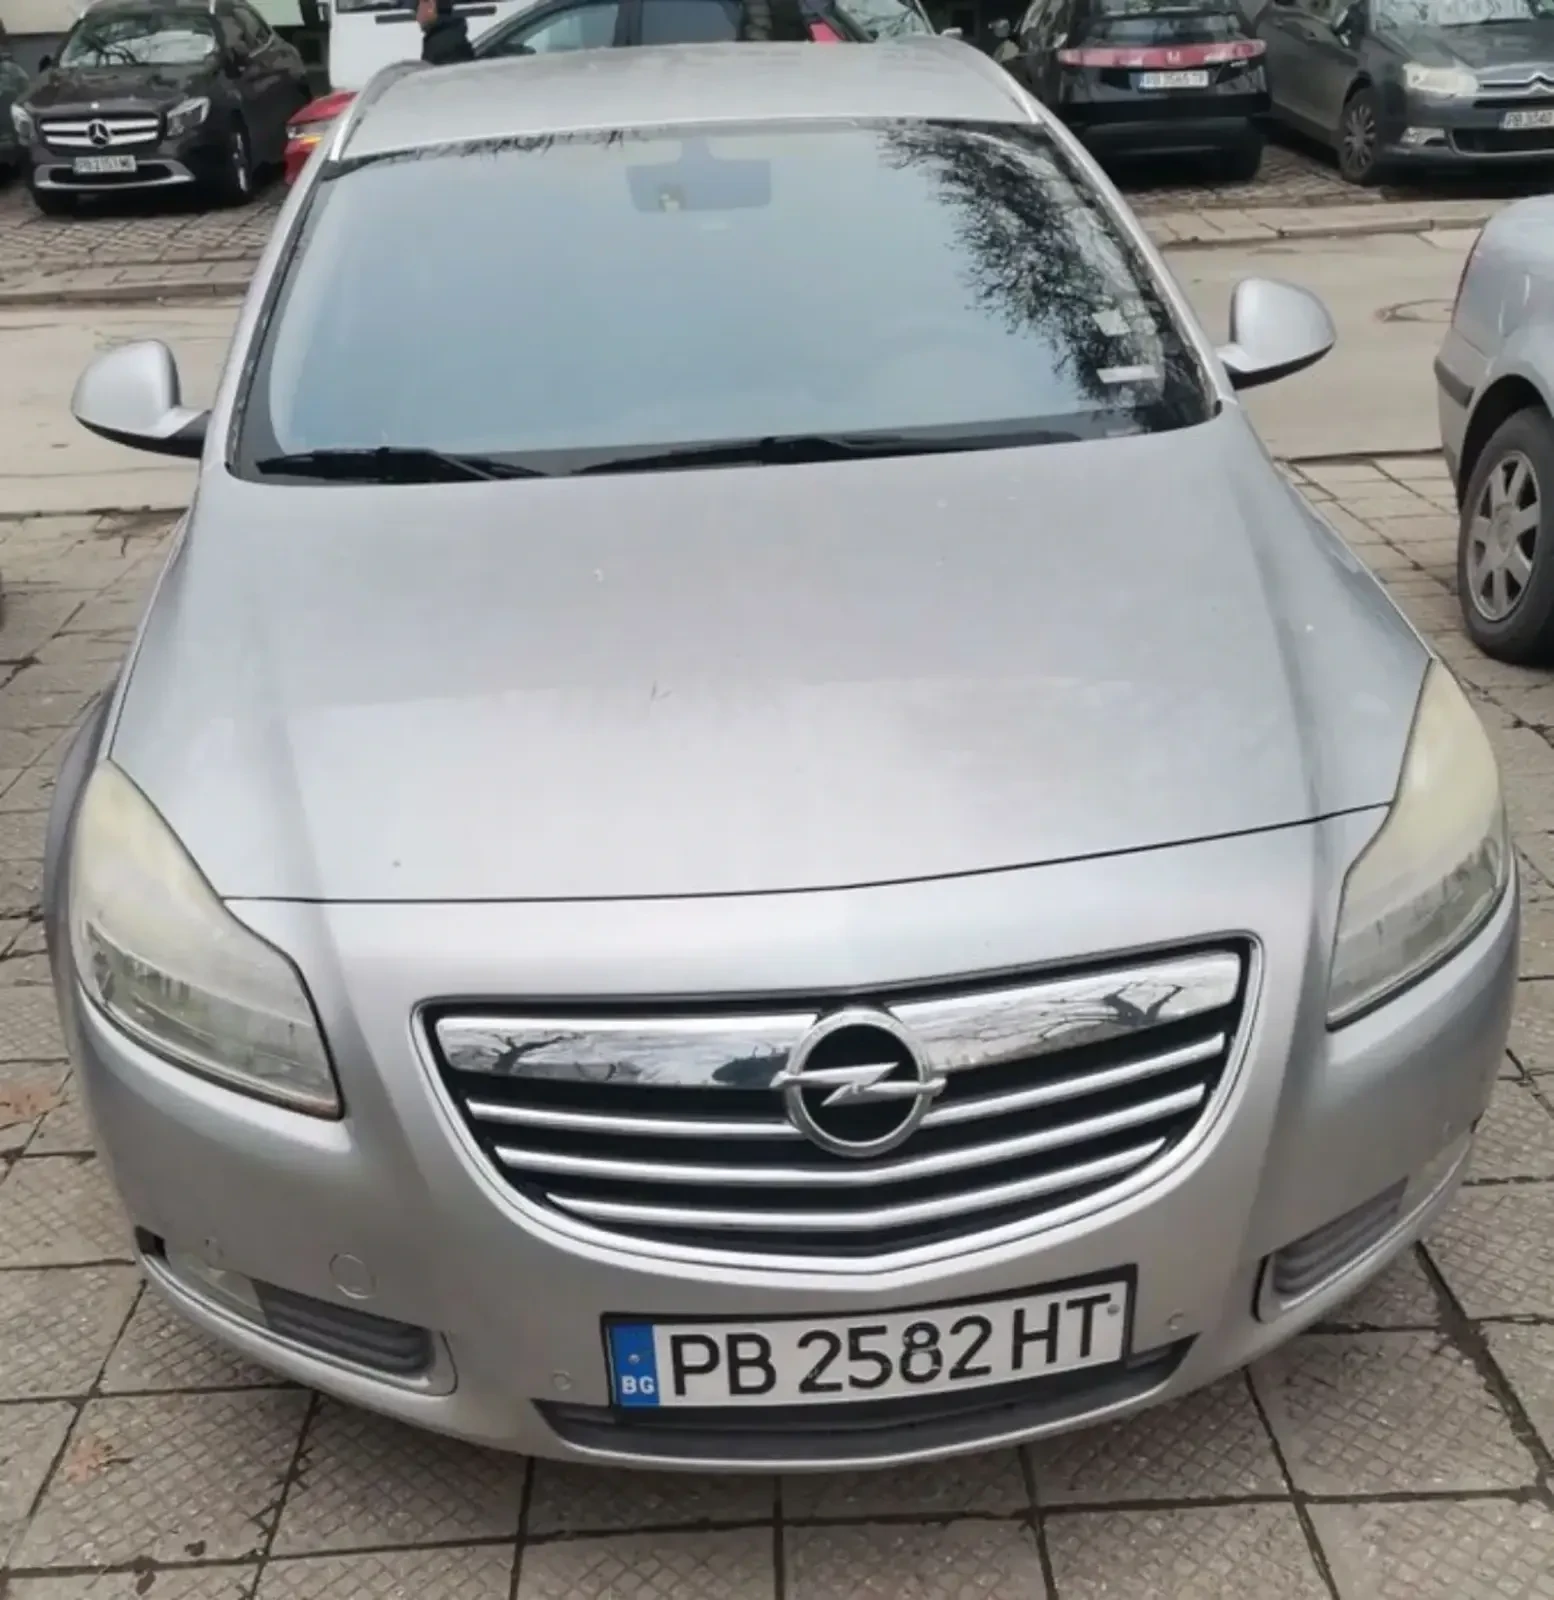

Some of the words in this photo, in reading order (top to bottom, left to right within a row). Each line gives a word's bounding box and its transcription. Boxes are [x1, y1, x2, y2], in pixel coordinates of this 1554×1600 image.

[670, 1333, 777, 1396] PB
[797, 1315, 992, 1393] 2582
[1011, 1293, 1111, 1371] HT
[621, 1375, 655, 1394] BG
